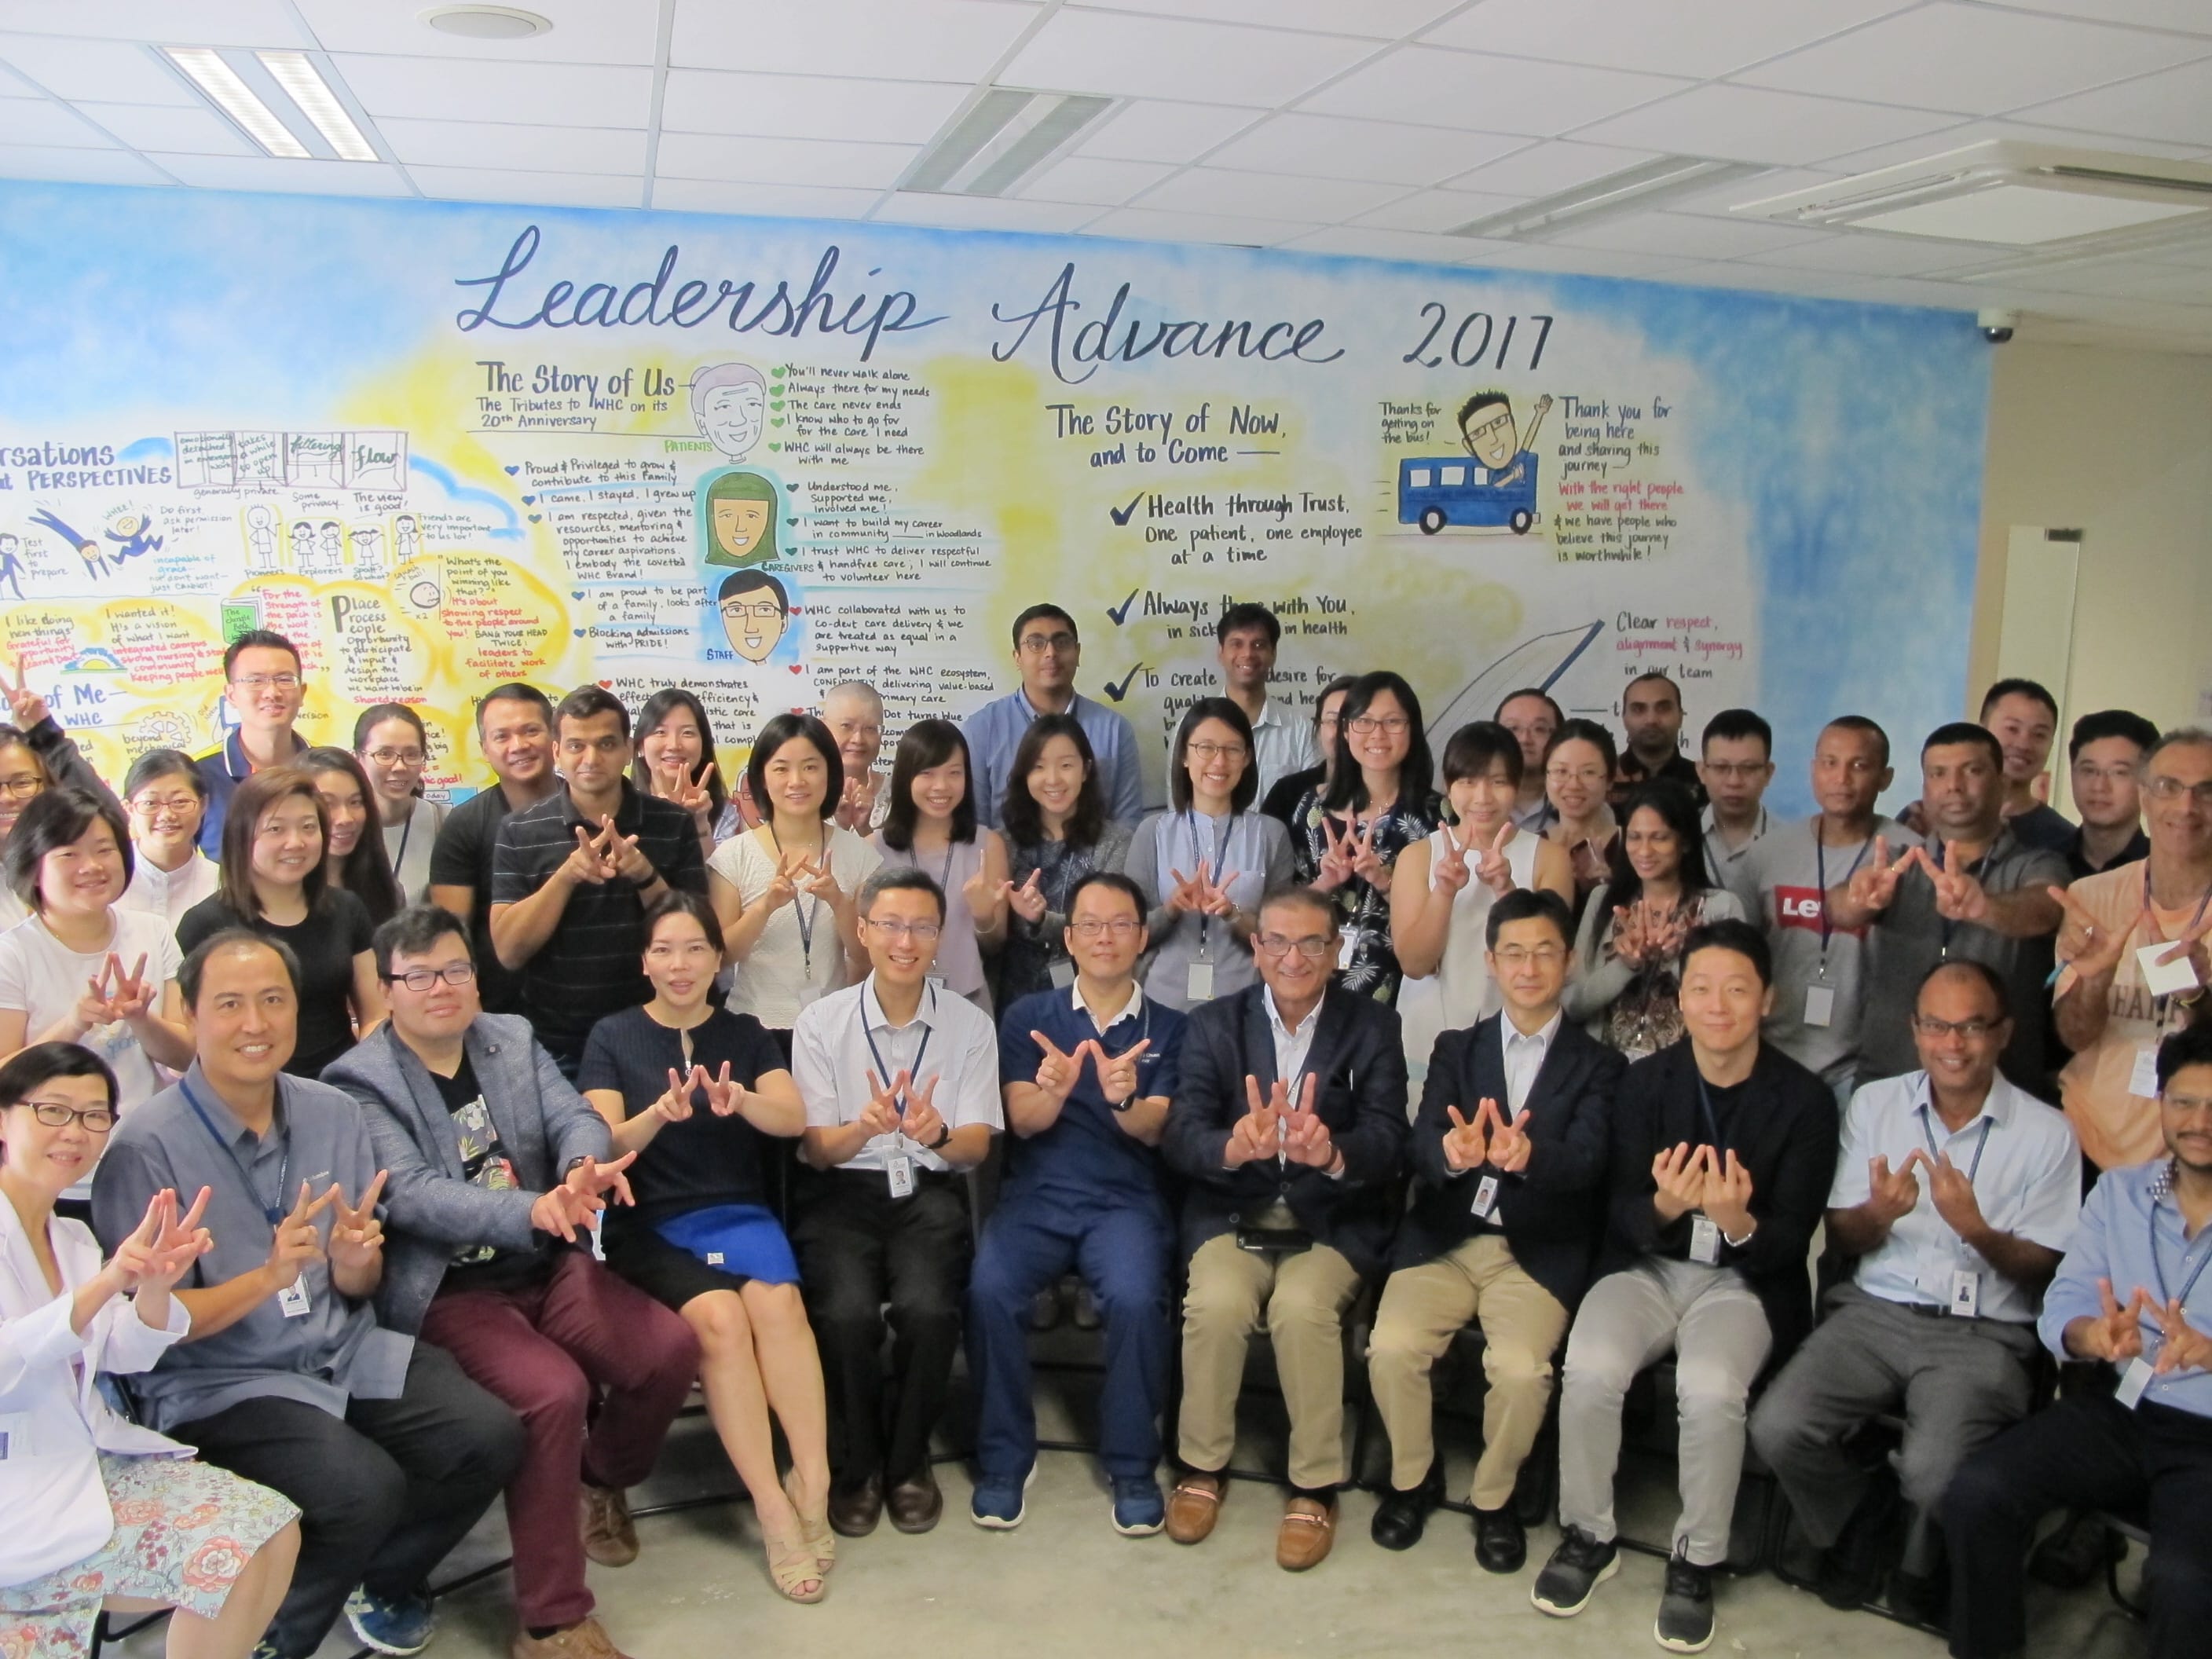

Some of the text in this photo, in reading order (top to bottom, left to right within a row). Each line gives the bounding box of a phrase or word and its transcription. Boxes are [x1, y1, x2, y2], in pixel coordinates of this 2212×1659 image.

[454, 225, 1554, 385] Leadership Advance 2017
[786, 364, 910, 381] You'll never walk alone
[475, 361, 676, 408] The Story of Us
[788, 383, 930, 402] Always there for my needs
[476, 397, 668, 412] The Tributes to WHC on its
[1379, 401, 1441, 416] Thanks for
[1558, 396, 1672, 428] Thank you for
[481, 414, 597, 431] 20th Anniversary
[1045, 402, 1287, 445] The Story of Now,
[1382, 418, 1434, 436] getting on
[1382, 430, 1430, 444] the bus!
[1566, 423, 1634, 443] being here
[290, 436, 344, 460] filtering
[351, 445, 400, 471] flow
[665, 441, 712, 452] PATIENTS
[785, 441, 925, 458] WHC will always be there
[1090, 438, 1228, 467] and to Come
[1558, 442, 1659, 466] and sharing this
[526, 461, 558, 474] Proud
[571, 459, 620, 474] Privileged
[641, 461, 665, 474] grow
[799, 455, 849, 465] with me
[27, 465, 172, 491] PERSPECTIVES
[1562, 460, 1607, 480] journey
[532, 475, 591, 487] contribute
[599, 474, 610, 482] to
[614, 472, 635, 482] this
[808, 482, 869, 492] Understood
[194, 488, 241, 500] generally
[292, 493, 320, 501] Some
[353, 492, 404, 503] The view
[1558, 481, 1683, 498] With the right people
[811, 493, 864, 507] Supported
[1148, 492, 1350, 522] Health through Trust,
[1566, 498, 1668, 515] we will get there
[620, 522, 673, 535] mentoring
[830, 529, 890, 544] community
[936, 529, 982, 538] Woodlands
[1145, 524, 1363, 551] One patient, one employee
[1171, 548, 1268, 565] at a time
[577, 570, 600, 580] WHC
[761, 562, 815, 573] CAREGIVERS
[804, 606, 831, 614] WHC
[838, 605, 901, 615] collaborated
[908, 606, 930, 615] with
[954, 606, 965, 615] to
[1143, 591, 1208, 621] Always
[1273, 595, 1309, 615] with
[1316, 595, 1355, 615] You,
[1284, 621, 1347, 635] in health
[1617, 611, 1658, 632] Clear
[589, 627, 690, 643] Blocking admissions
[606, 639, 628, 648] with
[707, 649, 734, 660] STAFF
[1616, 637, 1742, 661] alignment synergy
[1140, 668, 1218, 687] To create
[1316, 666, 1336, 684] for
[1624, 663, 1637, 676] in
[1679, 663, 1712, 679] team
[617, 679, 748, 689] WHC demonstrates
[882, 679, 994, 694] delivering value-based
[45, 683, 106, 709] of Me
[65, 712, 103, 726] WHC
[1782, 897, 1821, 917] Le
